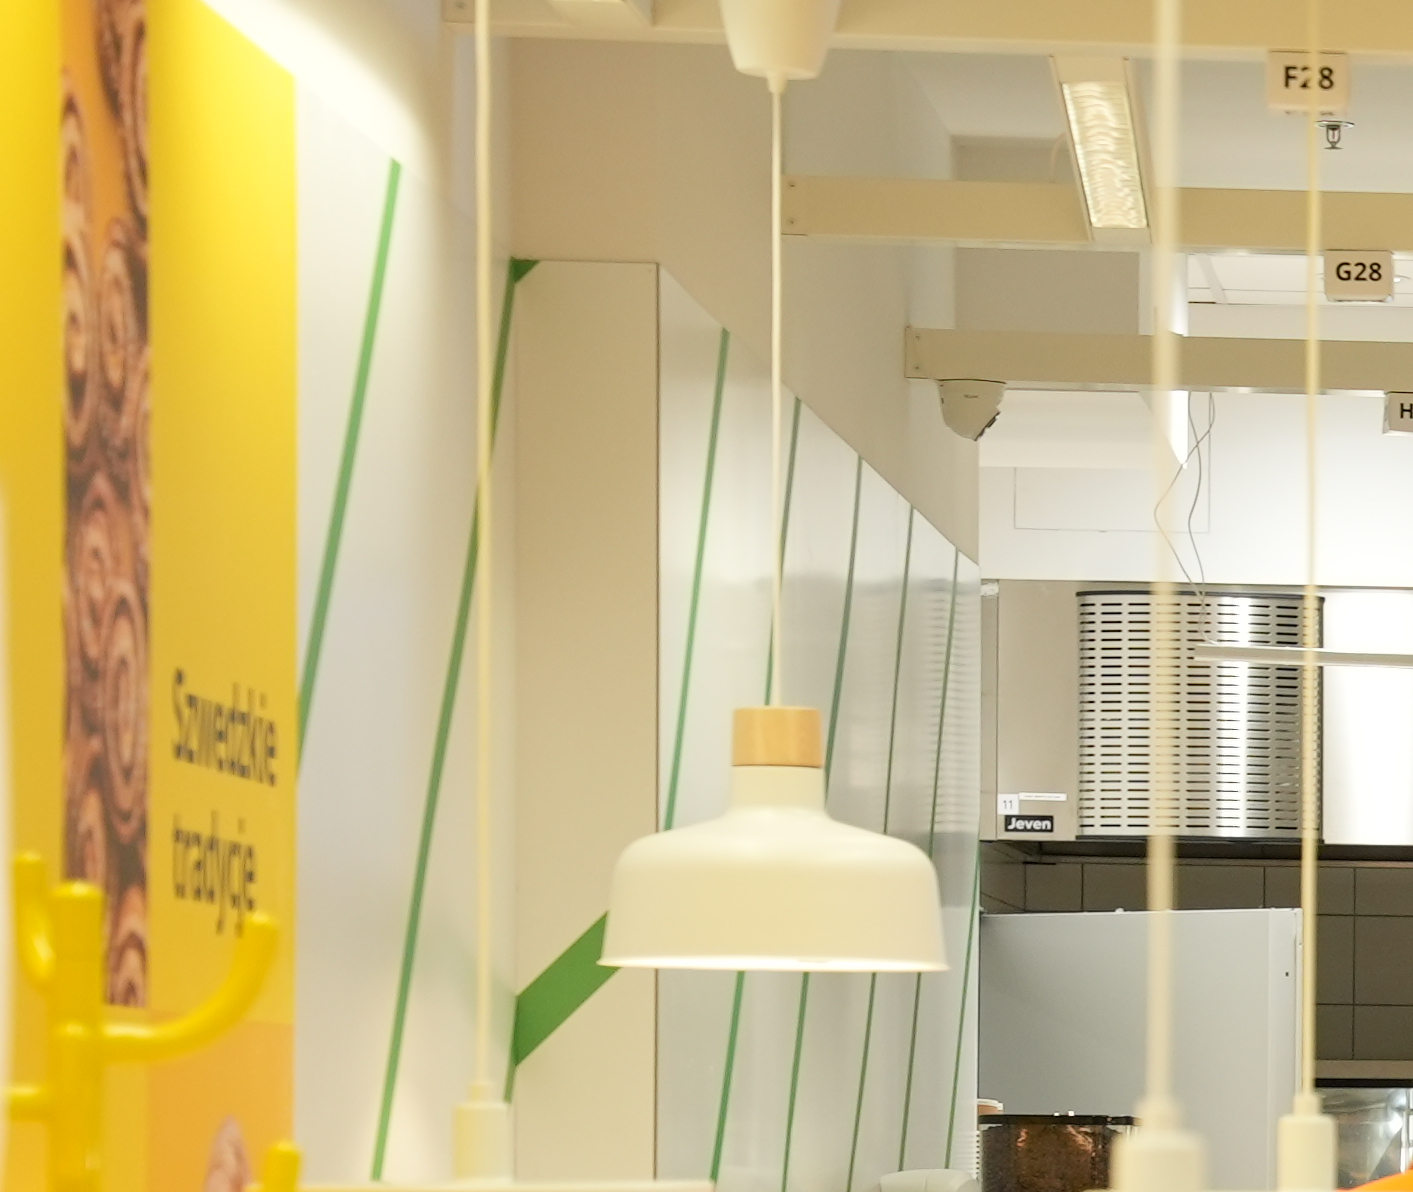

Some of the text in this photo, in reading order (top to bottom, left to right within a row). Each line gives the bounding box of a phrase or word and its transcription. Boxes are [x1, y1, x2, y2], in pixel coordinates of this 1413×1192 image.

[1335, 262, 1382, 282] G28
[171, 666, 277, 788] Szwedzkie
[1003, 800, 1013, 810] 11
[1007, 817, 1052, 831] Jeven
[172, 809, 257, 938] tradycje
